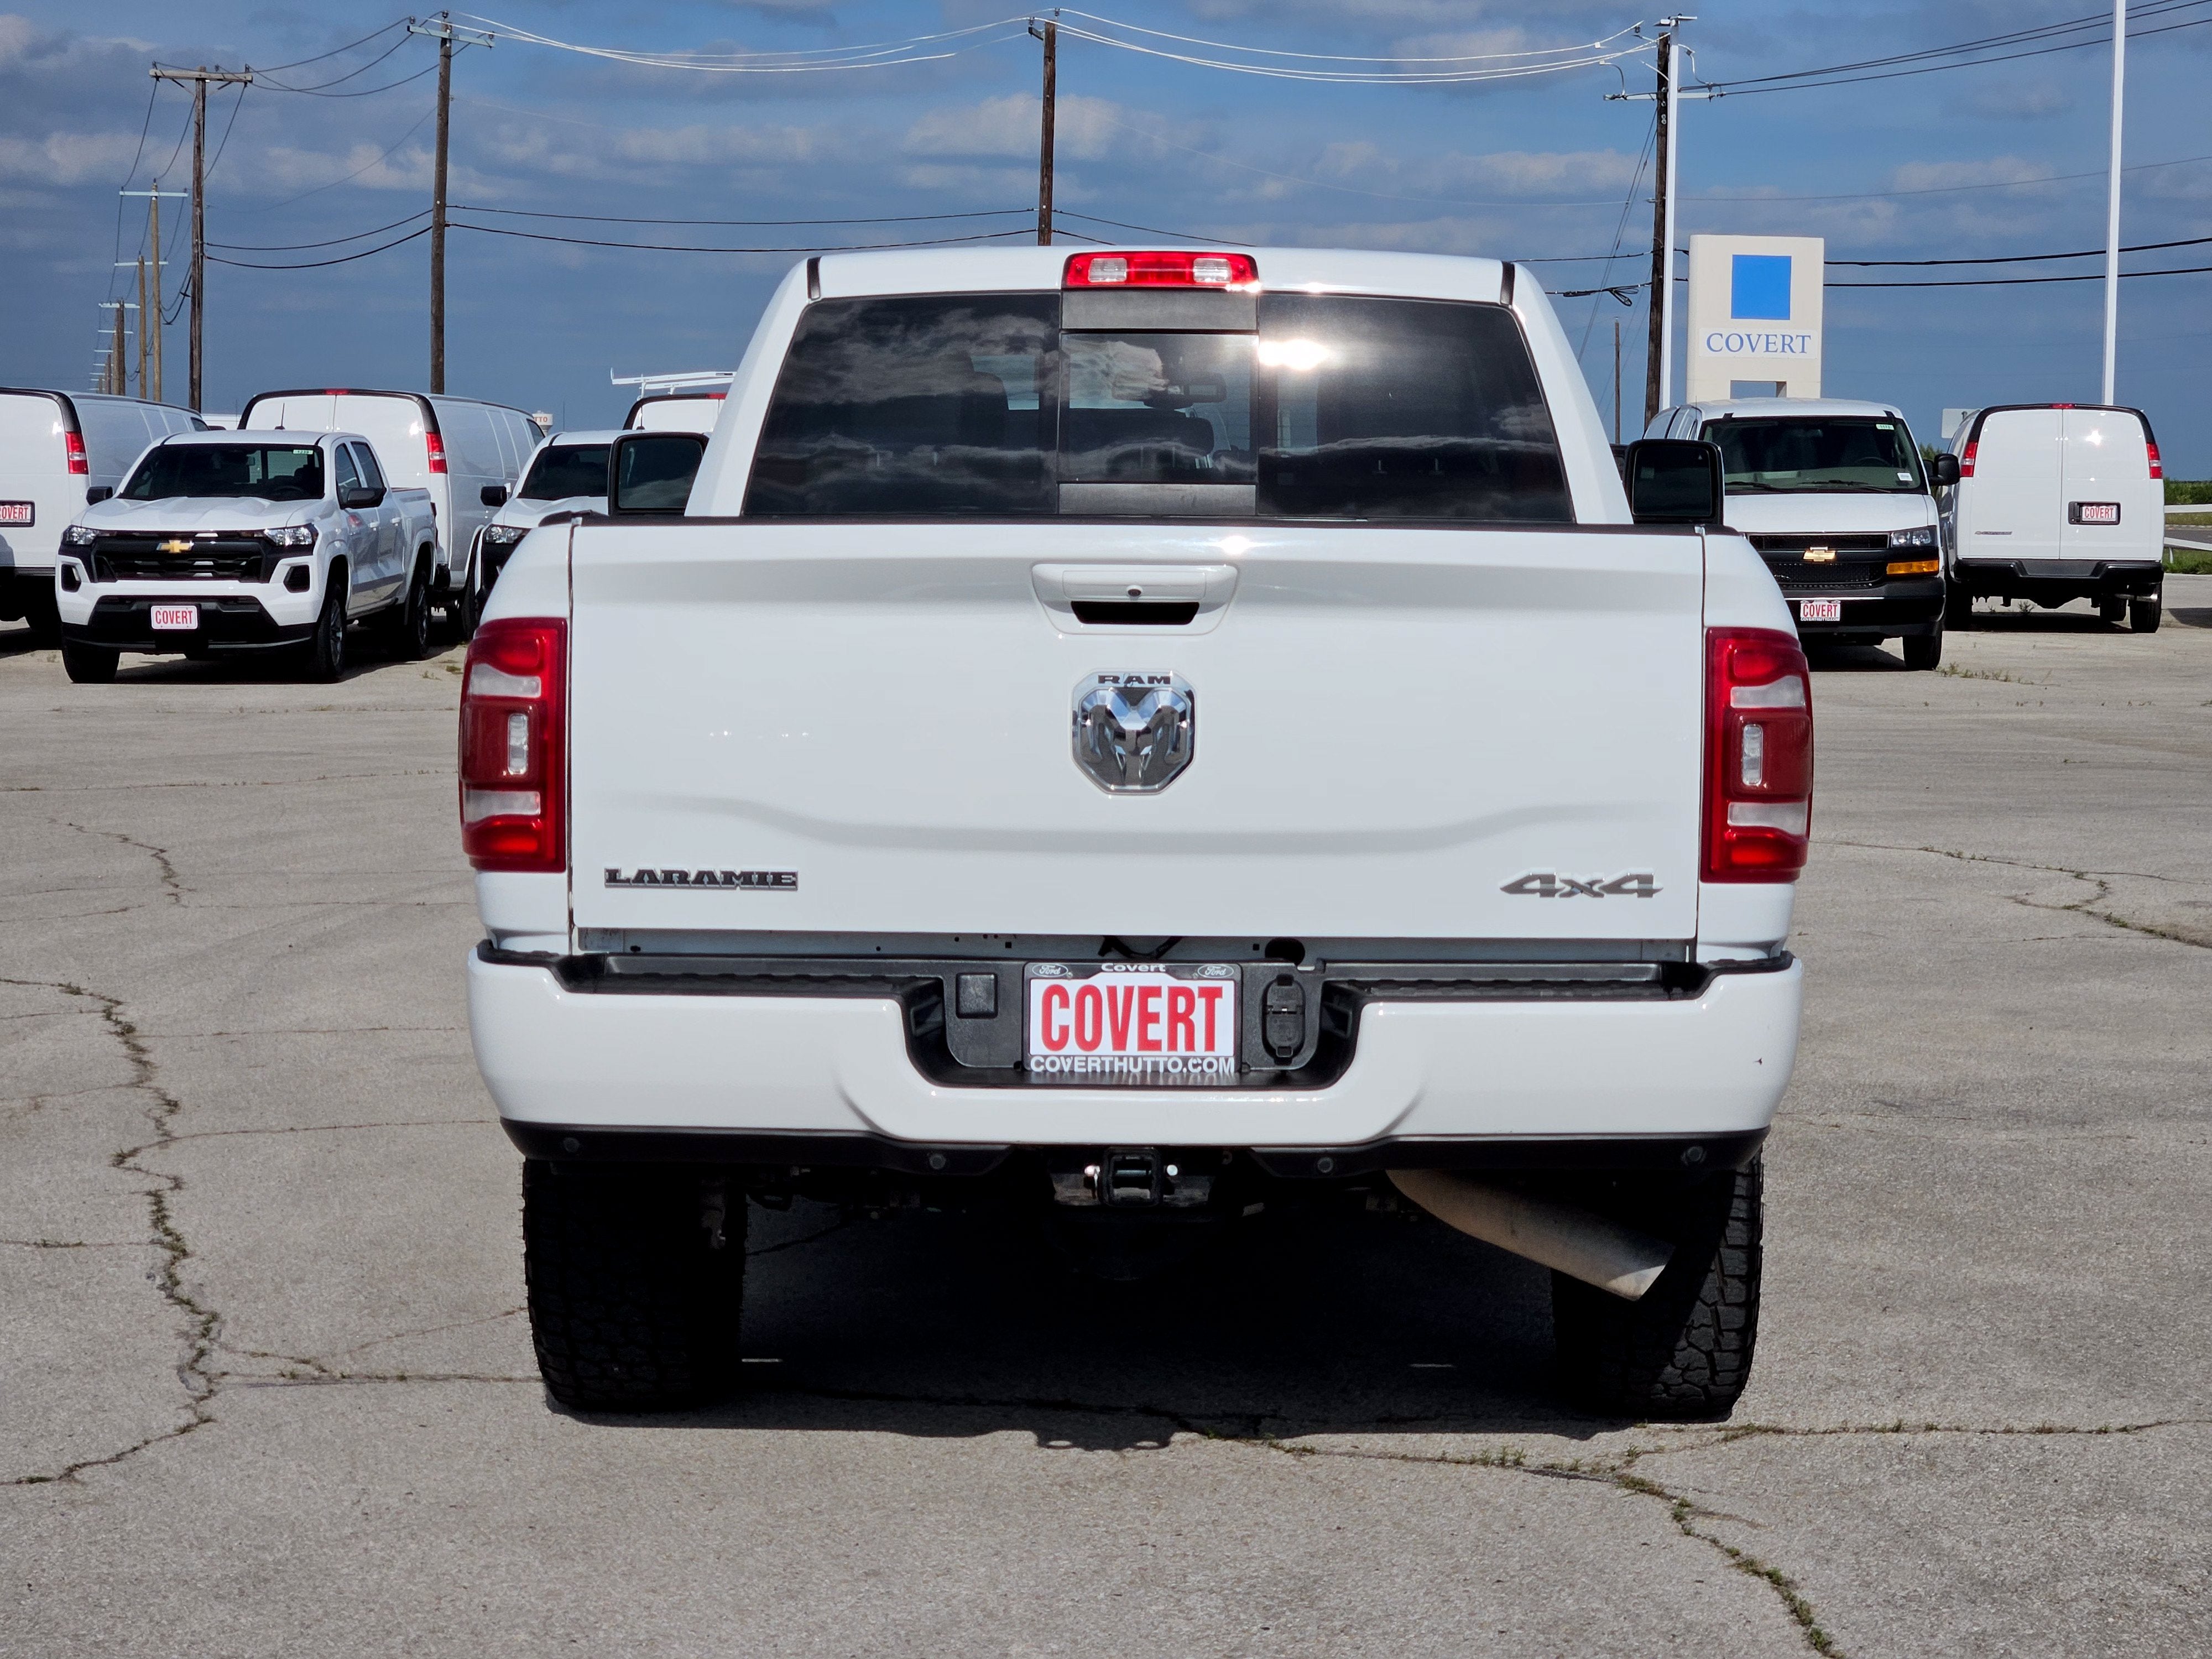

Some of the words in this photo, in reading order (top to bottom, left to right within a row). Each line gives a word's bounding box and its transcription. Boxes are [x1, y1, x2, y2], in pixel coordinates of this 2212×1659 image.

[1706, 332, 1812, 354] COVERT
[0, 507, 28, 519] OVERT
[2085, 507, 2114, 518] COVERT
[1803, 604, 1838, 617] COVERT
[155, 610, 192, 624] COVERT
[1098, 675, 1171, 685] RAM
[604, 867, 799, 891] LARAMIE
[1039, 964, 1061, 975] Ford
[1101, 963, 1166, 973] Covert
[1204, 965, 1227, 976] Ford
[1041, 984, 1223, 1052] COVERT
[1030, 1056, 1235, 1073] COVERTHUTTO.COM
